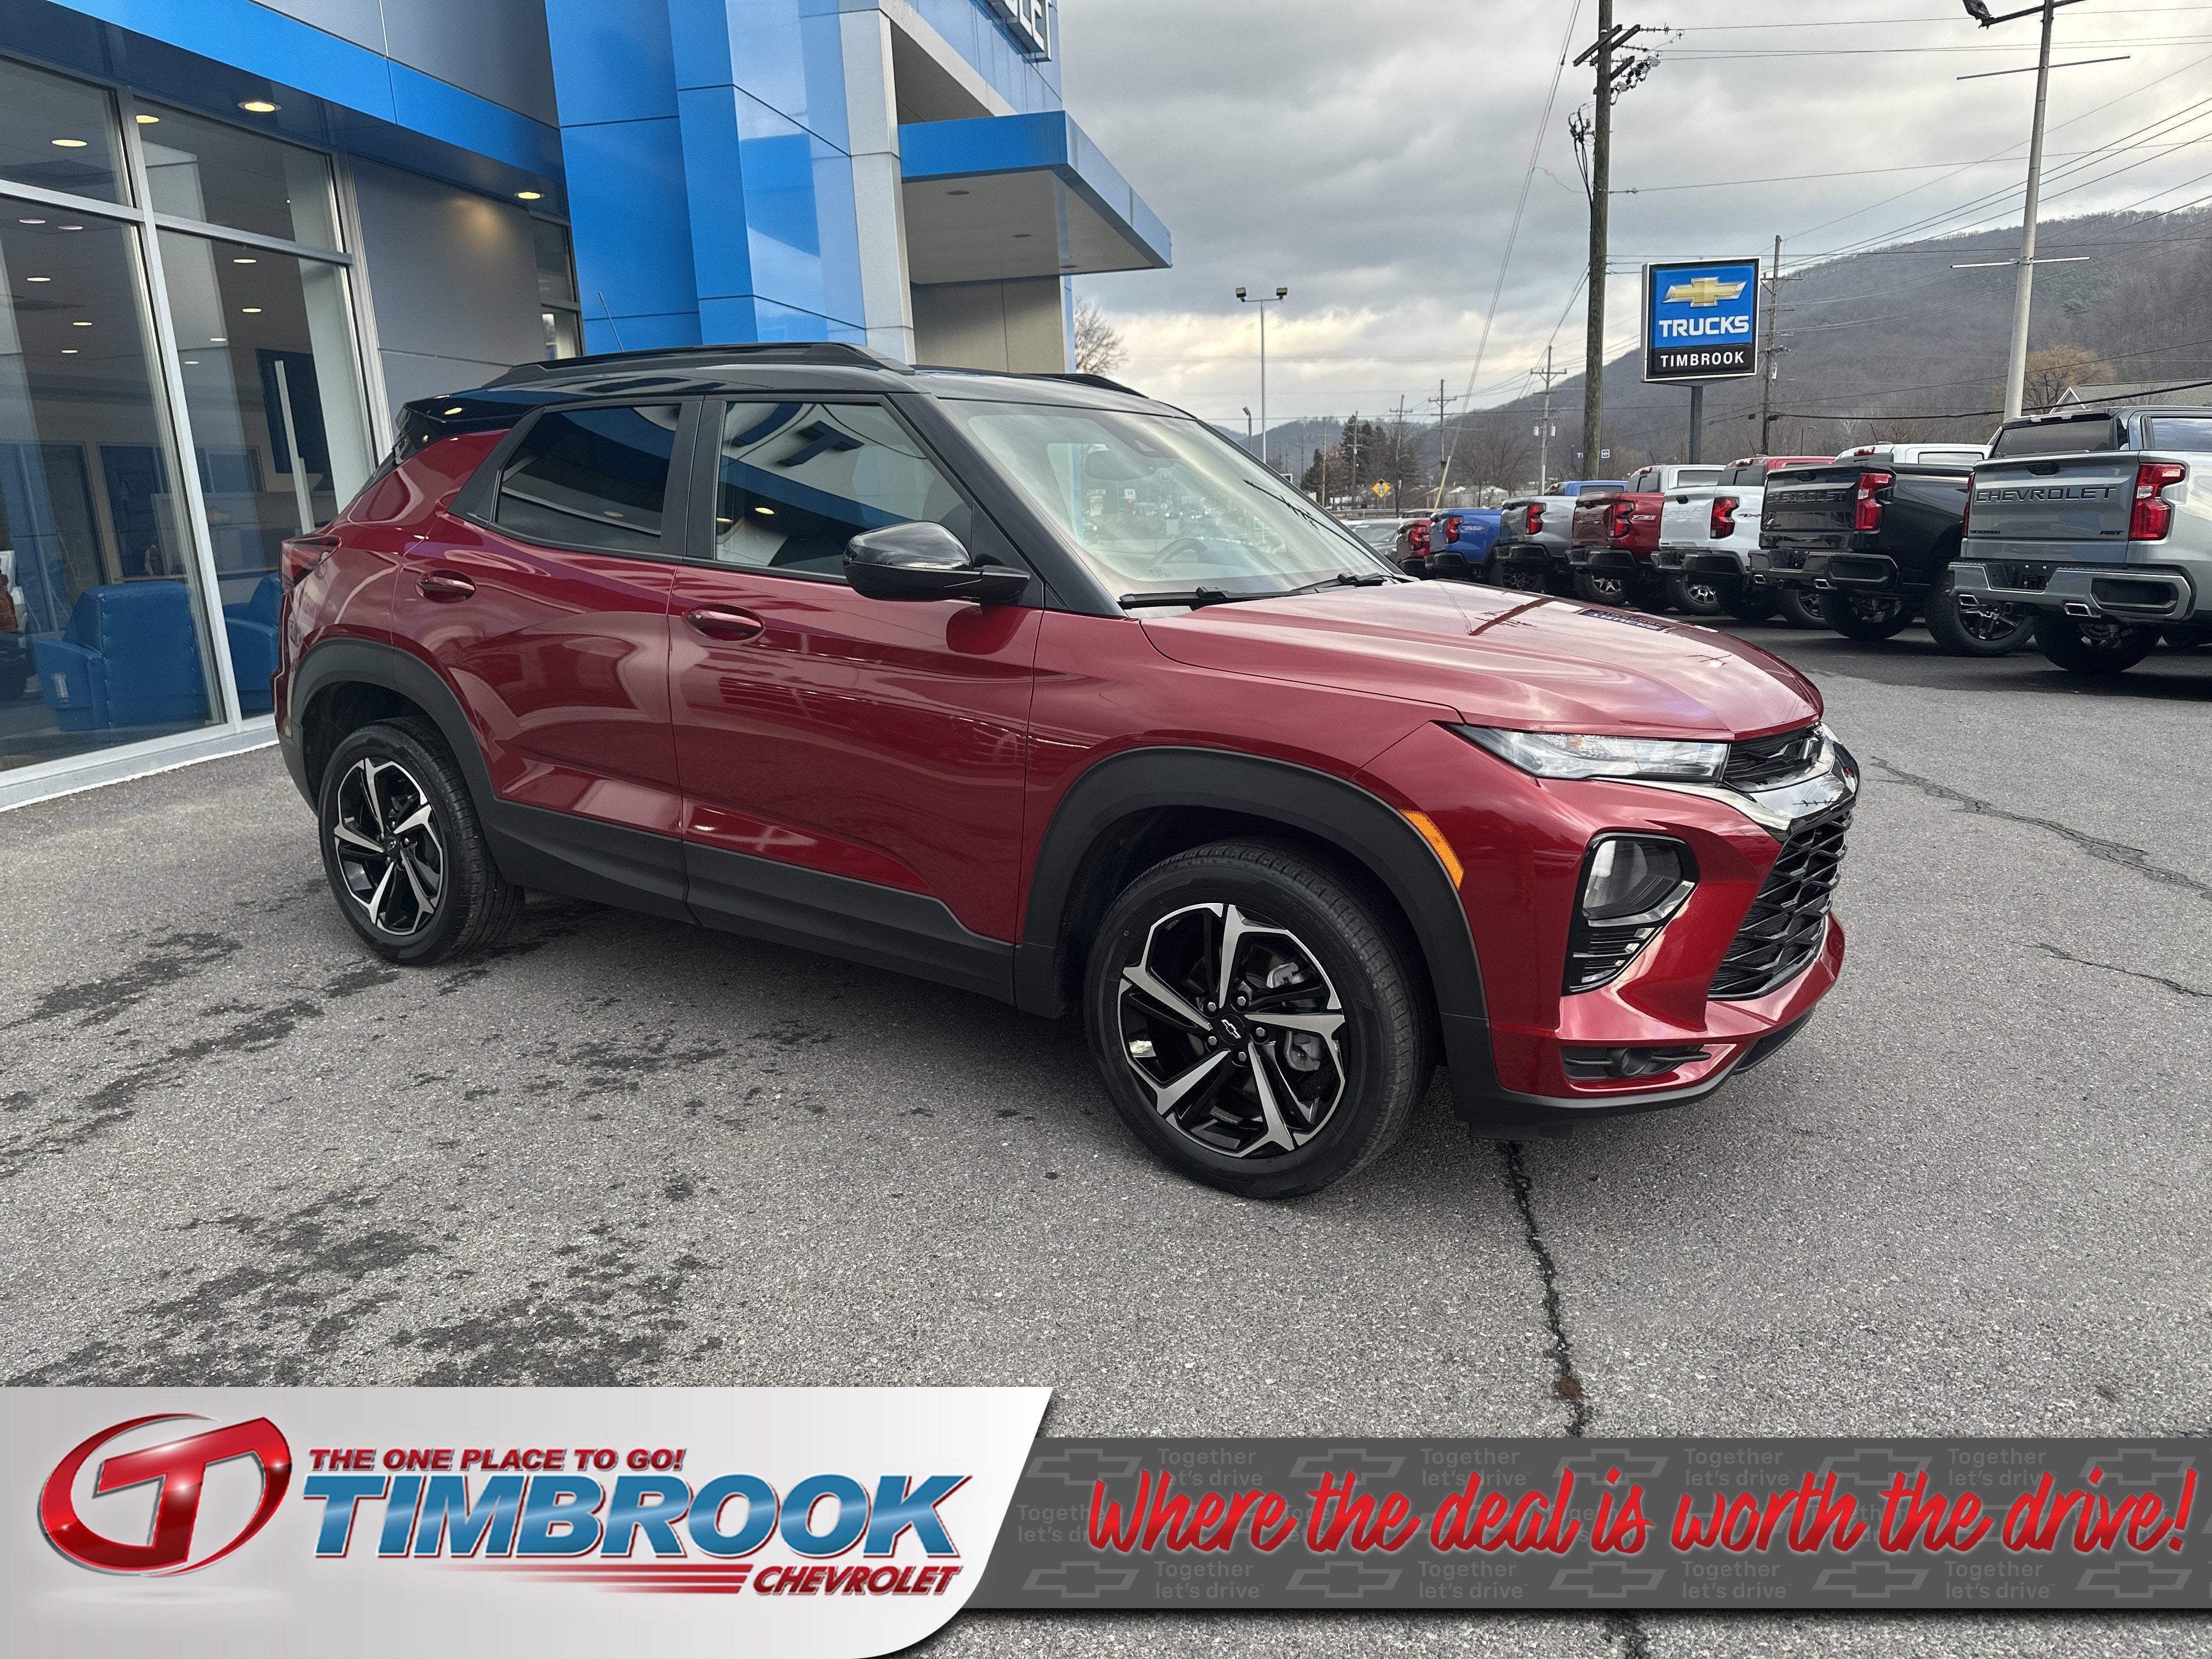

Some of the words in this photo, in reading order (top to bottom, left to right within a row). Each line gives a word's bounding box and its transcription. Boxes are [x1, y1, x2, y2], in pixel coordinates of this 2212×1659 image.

[1658, 315, 1750, 338] TRUCKS
[1660, 351, 1745, 368] TIMBROOK
[1766, 491, 1847, 504] CHEVROLET
[1976, 487, 2117, 503] CHEVROLET
